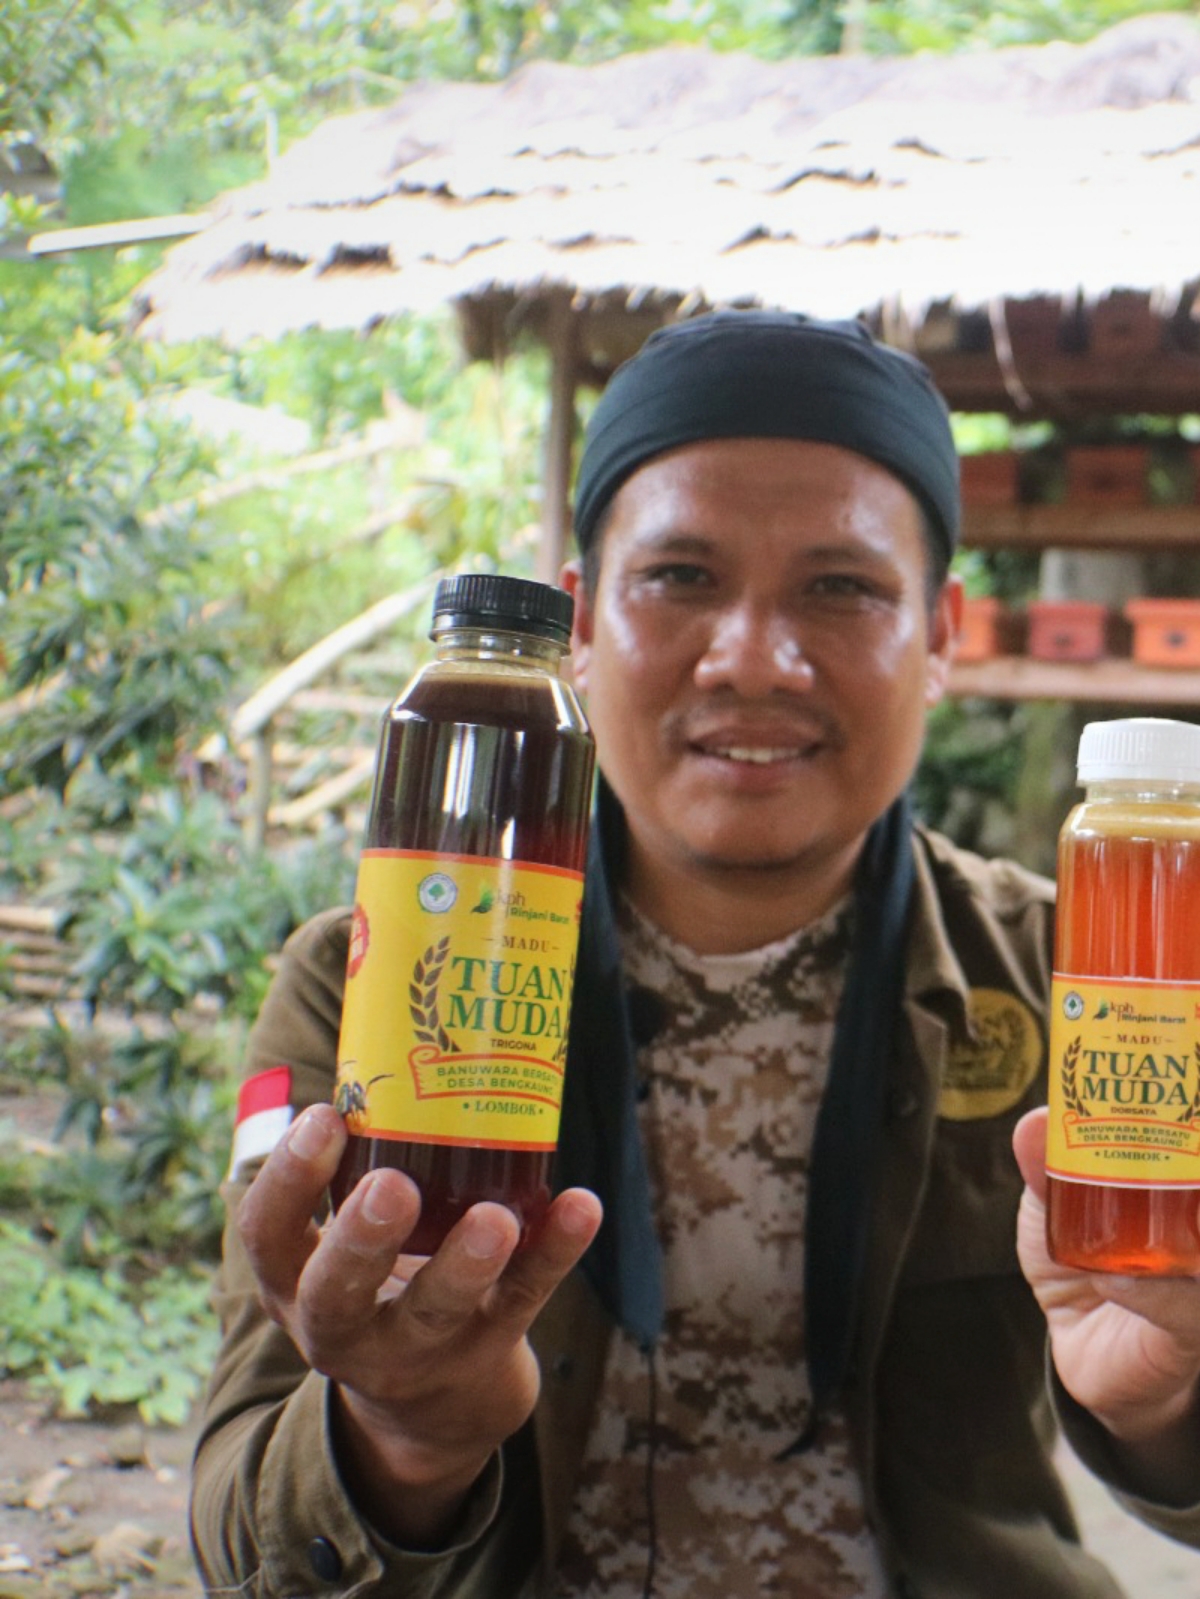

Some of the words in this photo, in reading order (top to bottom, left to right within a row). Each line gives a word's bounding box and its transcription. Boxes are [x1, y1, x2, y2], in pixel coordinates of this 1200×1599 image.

[510, 907, 547, 921] Rinjani
[502, 935, 551, 953] MADU
[451, 957, 567, 1001] TUAN
[445, 995, 562, 1038] MUDA
[1122, 1013, 1157, 1024] Rinjani
[490, 1038, 537, 1051] TRIGONA
[1117, 1034, 1163, 1045] MADU
[1082, 1050, 1190, 1079] TUAN
[437, 1065, 518, 1077] BANUWARA
[523, 1068, 558, 1085] BERSAT
[447, 1078, 485, 1088] DESA
[1081, 1076, 1190, 1106] MUDA
[475, 1100, 537, 1116] LOMBOK
[1110, 1106, 1157, 1116] DORSATA
[1077, 1126, 1138, 1134] BANUWARA
[1142, 1127, 1191, 1140] BERSATU
[1083, 1134, 1111, 1142] DESA
[1114, 1134, 1183, 1148] BENGKAUNG
[1103, 1149, 1162, 1161] LOMBOK
